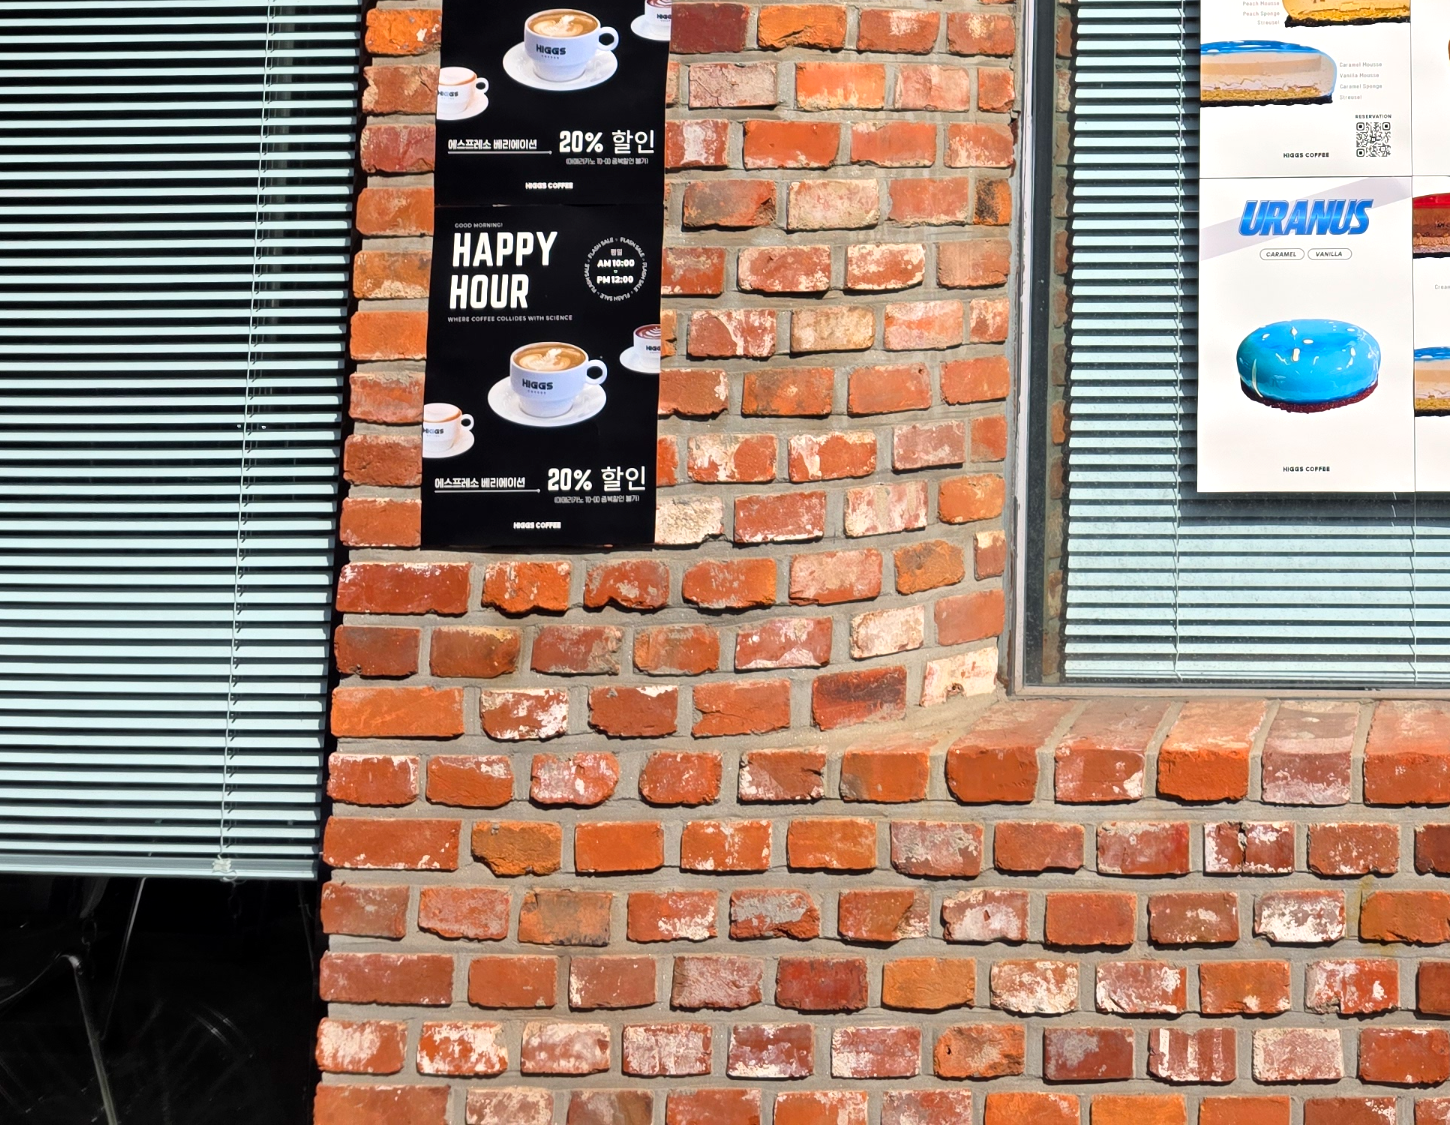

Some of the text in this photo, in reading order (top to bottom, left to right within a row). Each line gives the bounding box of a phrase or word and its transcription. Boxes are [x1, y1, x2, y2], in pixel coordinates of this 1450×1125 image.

[536, 43, 566, 55] HIGGS
[448, 139, 537, 150] 에스프레소 베리에이션
[559, 129, 654, 154] 20% 할인
[525, 181, 574, 190] HIGGS COFFEE
[1238, 198, 1374, 236] URANUS
[453, 231, 558, 267] HAPPY
[596, 259, 635, 268] AM 10:00
[596, 275, 634, 284] PM 12:00
[450, 274, 530, 309] HOUR
[522, 378, 553, 390] HIGGS
[434, 476, 525, 489] 에스프레소 베리에이션
[547, 465, 646, 492] 20% 할인
[513, 521, 561, 530] HIGGS COFFEE
